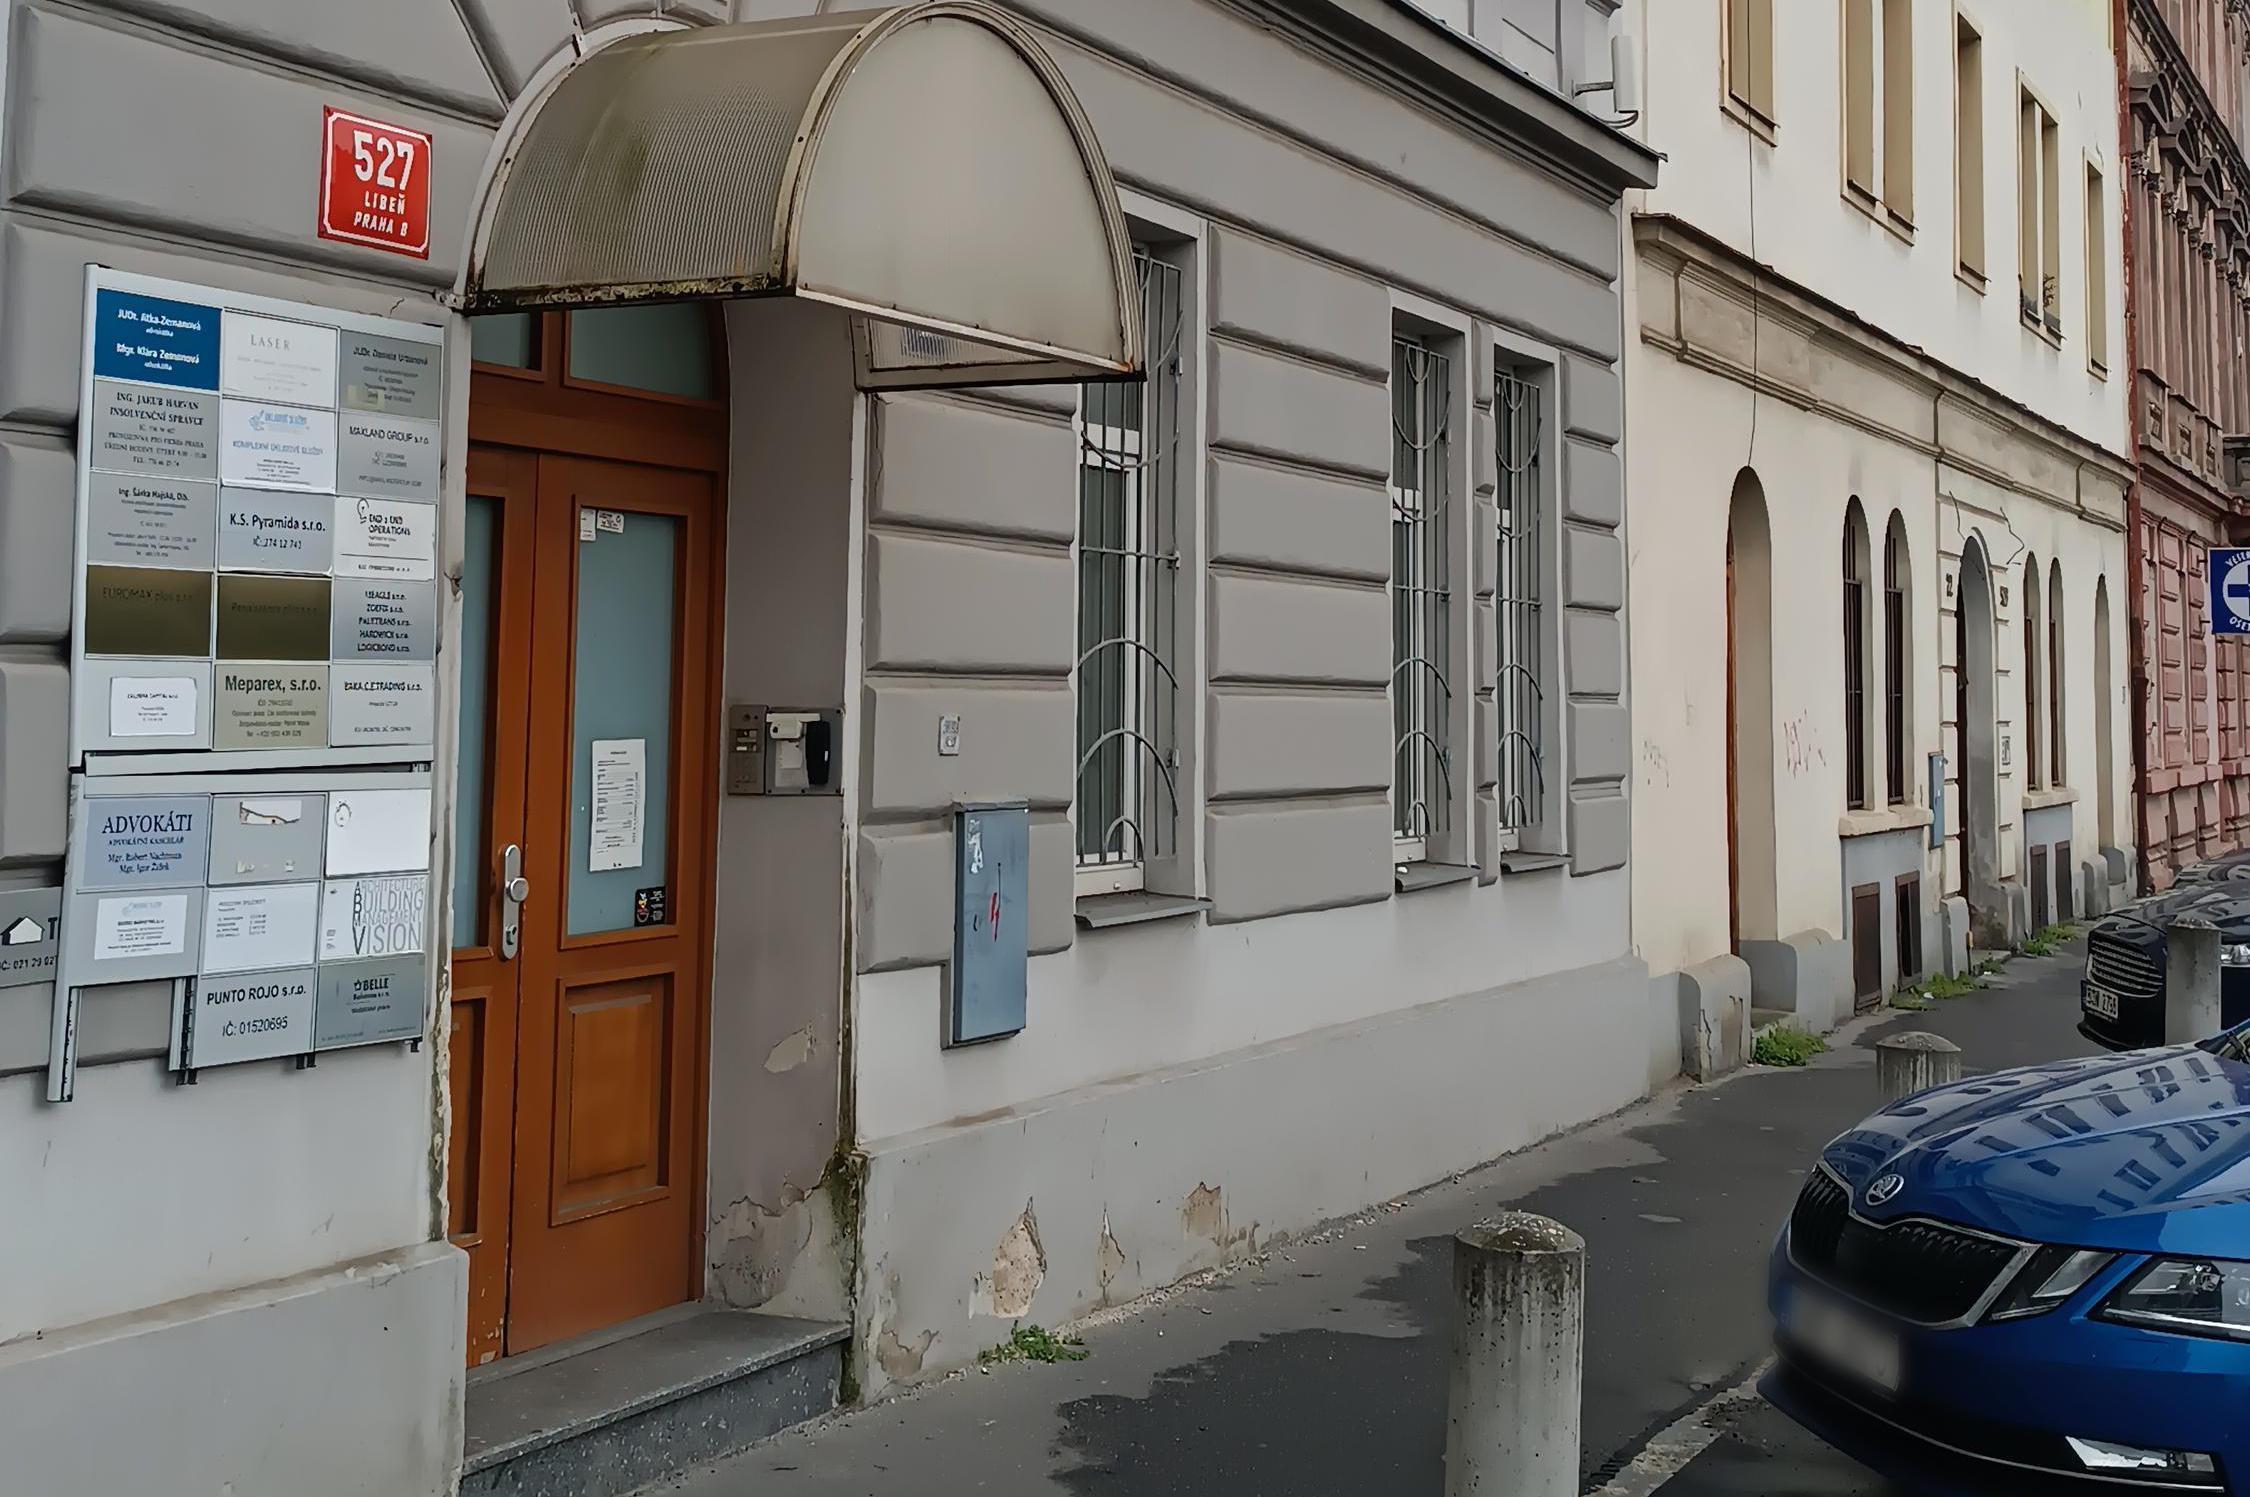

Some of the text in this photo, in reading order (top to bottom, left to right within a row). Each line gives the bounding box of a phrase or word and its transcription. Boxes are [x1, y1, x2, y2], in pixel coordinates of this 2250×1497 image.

[353, 130, 414, 191] 527
[364, 190, 406, 215] LIBEŇ
[354, 211, 409, 237] PRAHA 8
[250, 334, 290, 351] LASER
[230, 513, 326, 532] K.S. Pyramida s.r.o.
[225, 675, 321, 694] Meparex, s.r.o.
[101, 810, 193, 834] ADVOKÁTI
[354, 888, 424, 914] BUILDING
[352, 921, 421, 955] VISION
[207, 984, 307, 1005] PUNTO ROJO s.r.o.
[239, 1015, 288, 1035] 01520695
